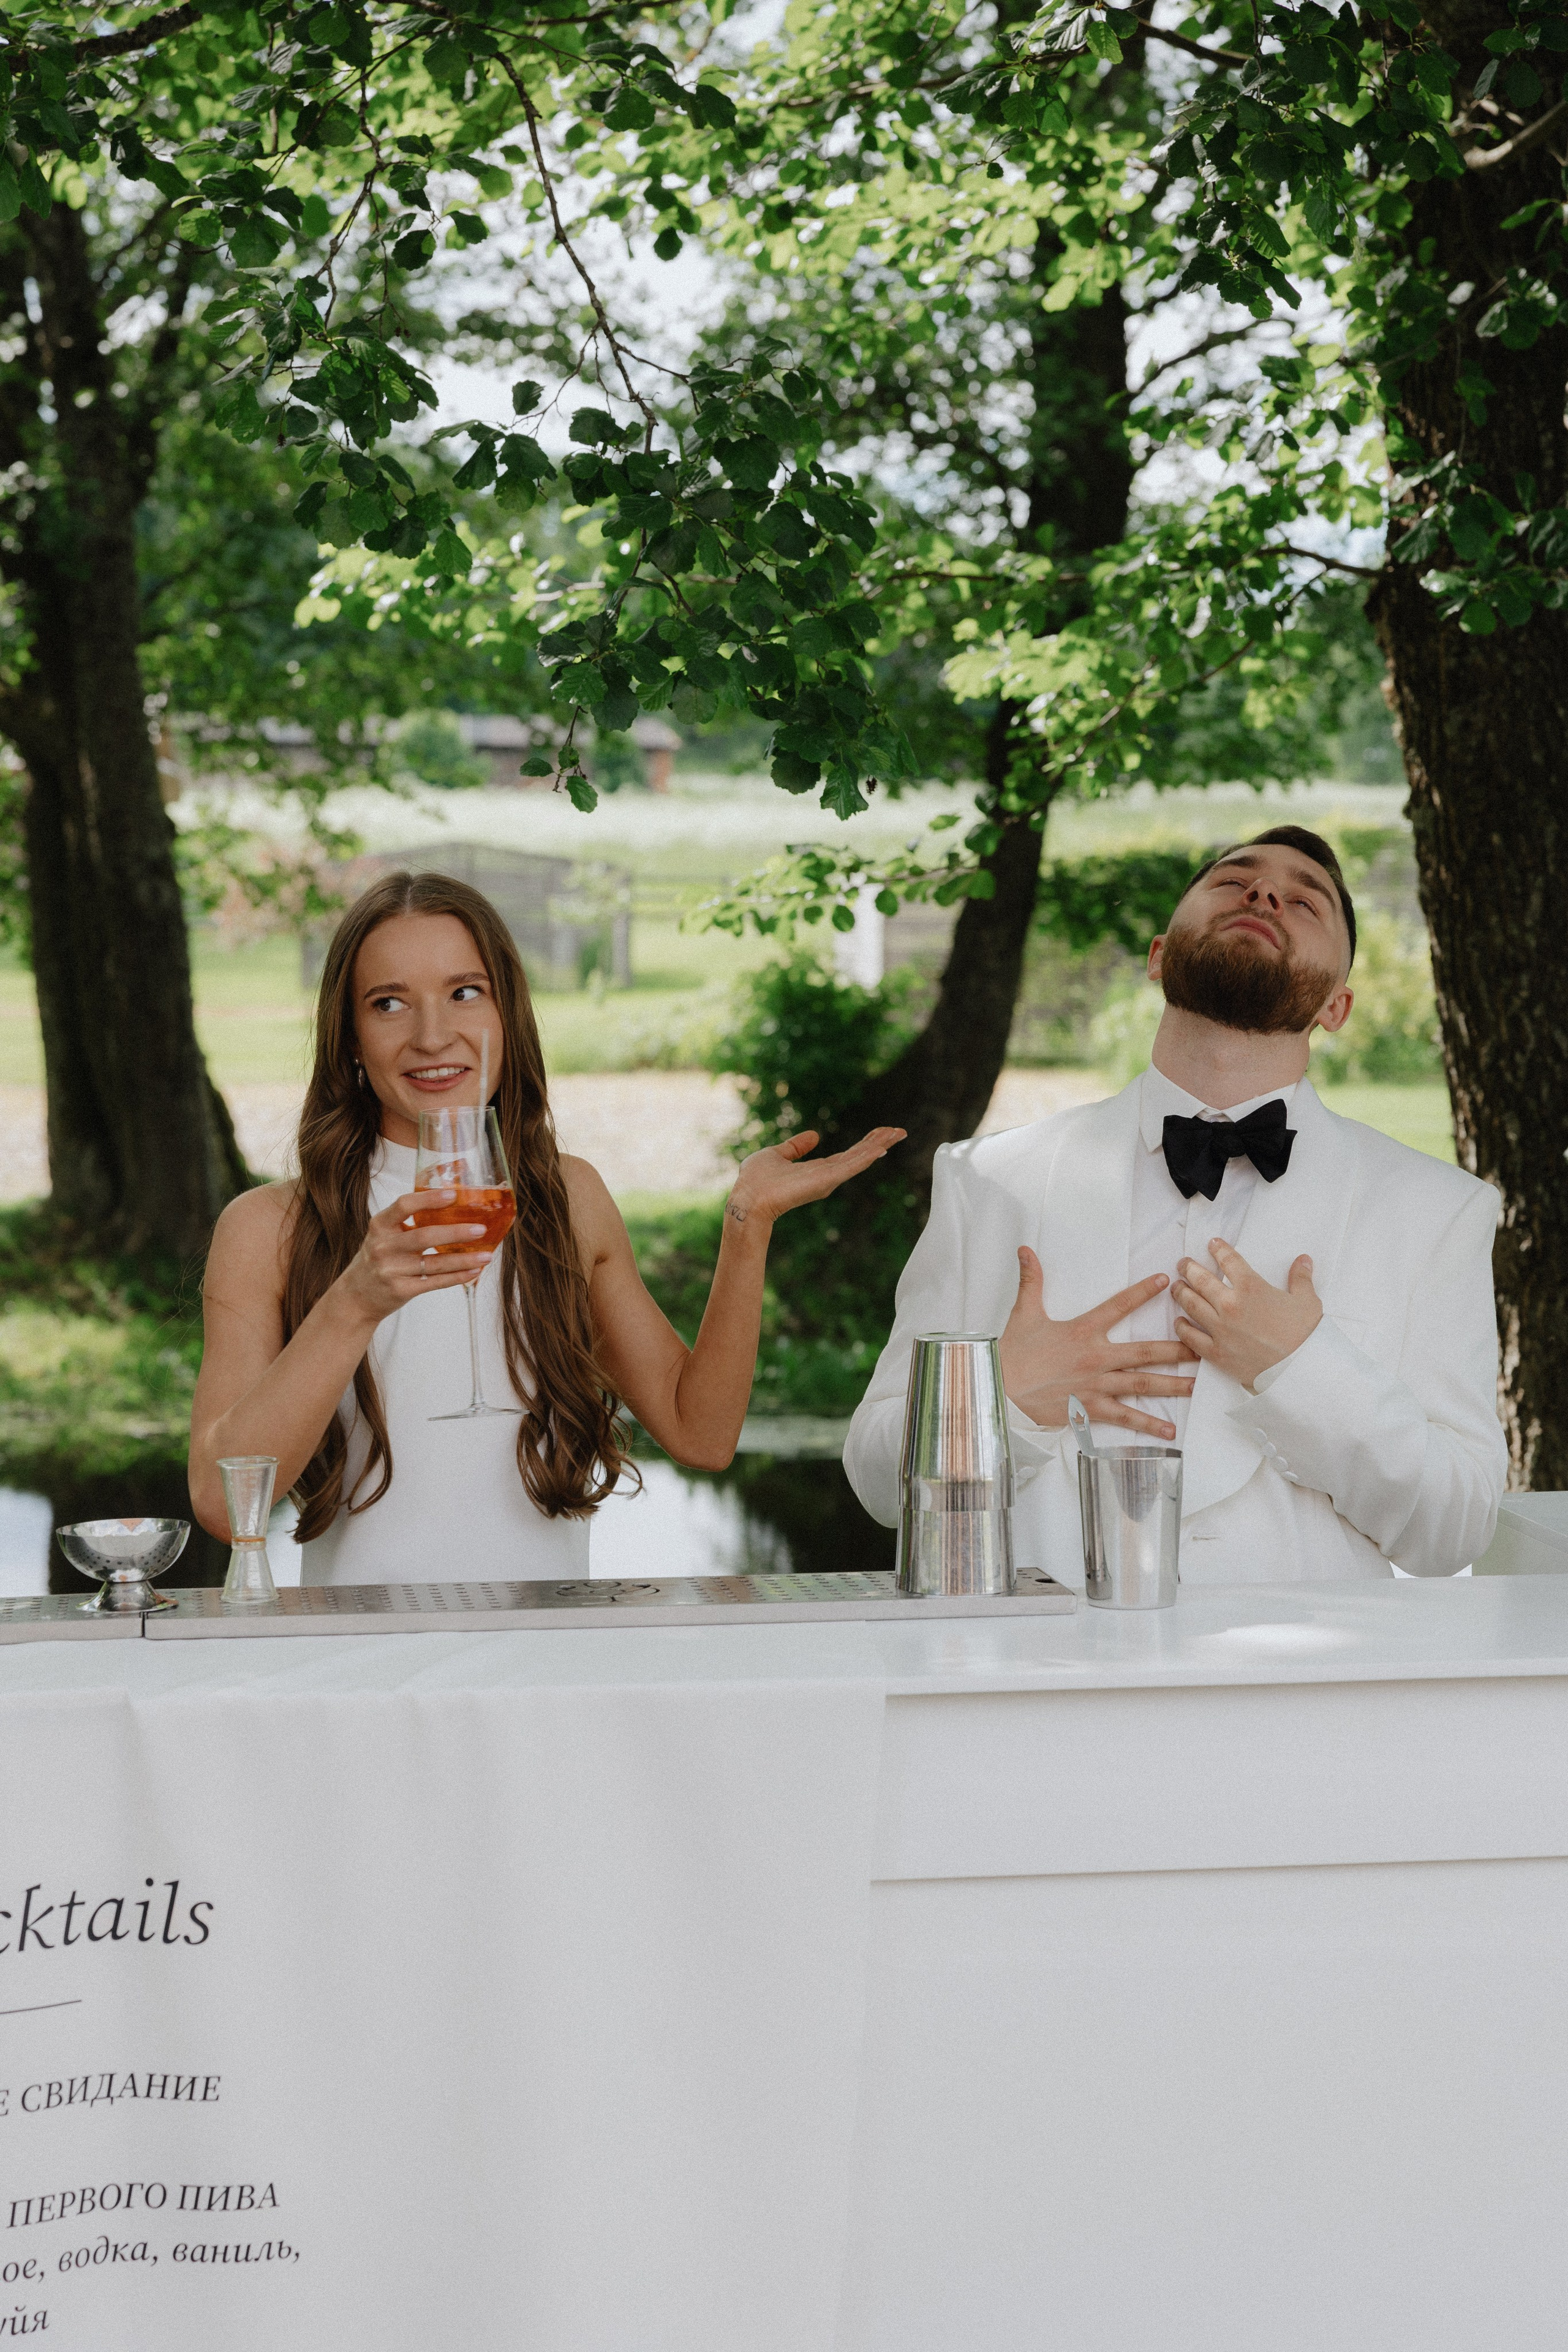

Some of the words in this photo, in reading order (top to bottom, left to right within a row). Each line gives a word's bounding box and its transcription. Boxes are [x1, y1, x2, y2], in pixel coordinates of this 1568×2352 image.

[20, 2072, 221, 2113] СВИДАНИЕ
[6, 2182, 168, 2228] ПЕРВОГО
[176, 2182, 280, 2212] ПИВА
[58, 2235, 159, 2272] водка,
[172, 2239, 301, 2264] ваниль,
